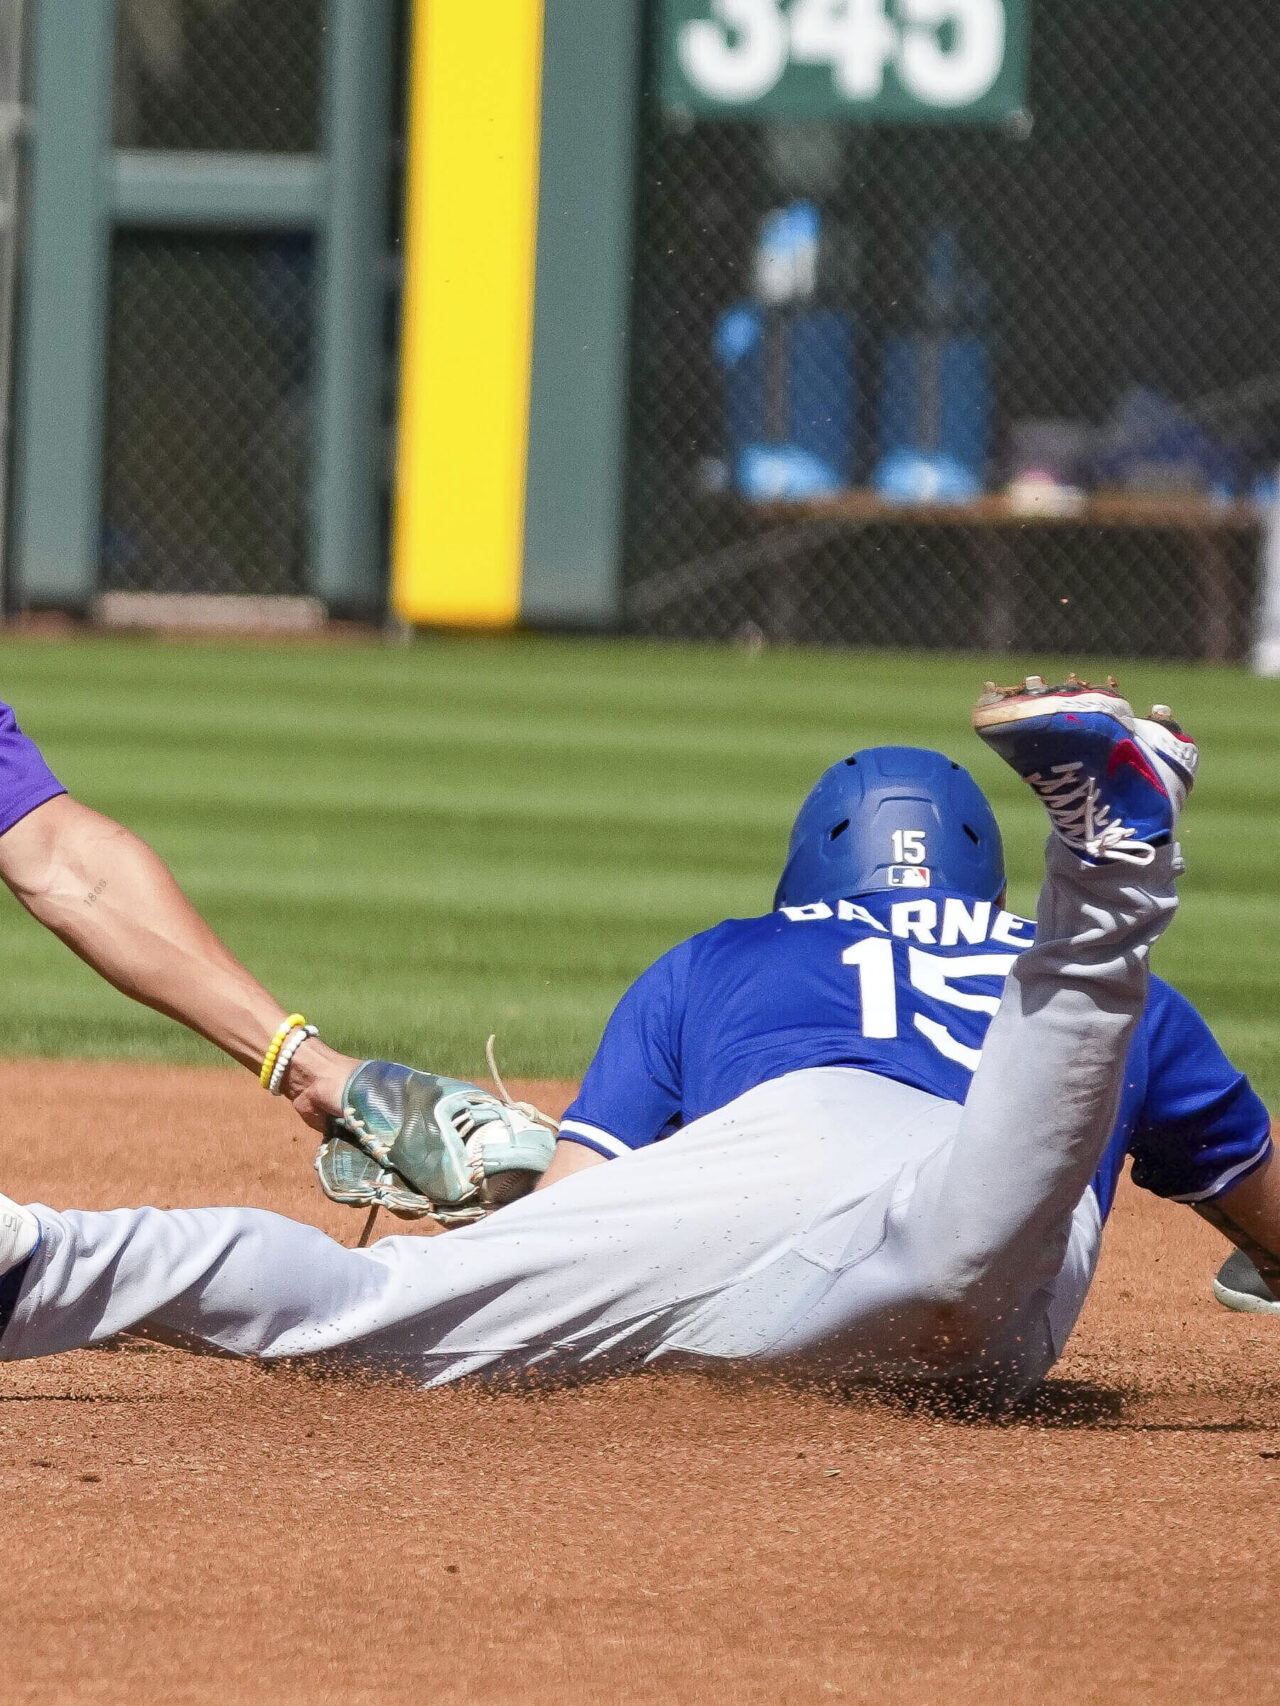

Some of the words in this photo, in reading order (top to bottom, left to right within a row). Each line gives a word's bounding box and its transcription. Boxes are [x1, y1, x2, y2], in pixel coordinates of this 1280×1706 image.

[677, 0, 1006, 107] 345
[891, 829, 926, 864] 15
[842, 936, 1019, 1072] 15
